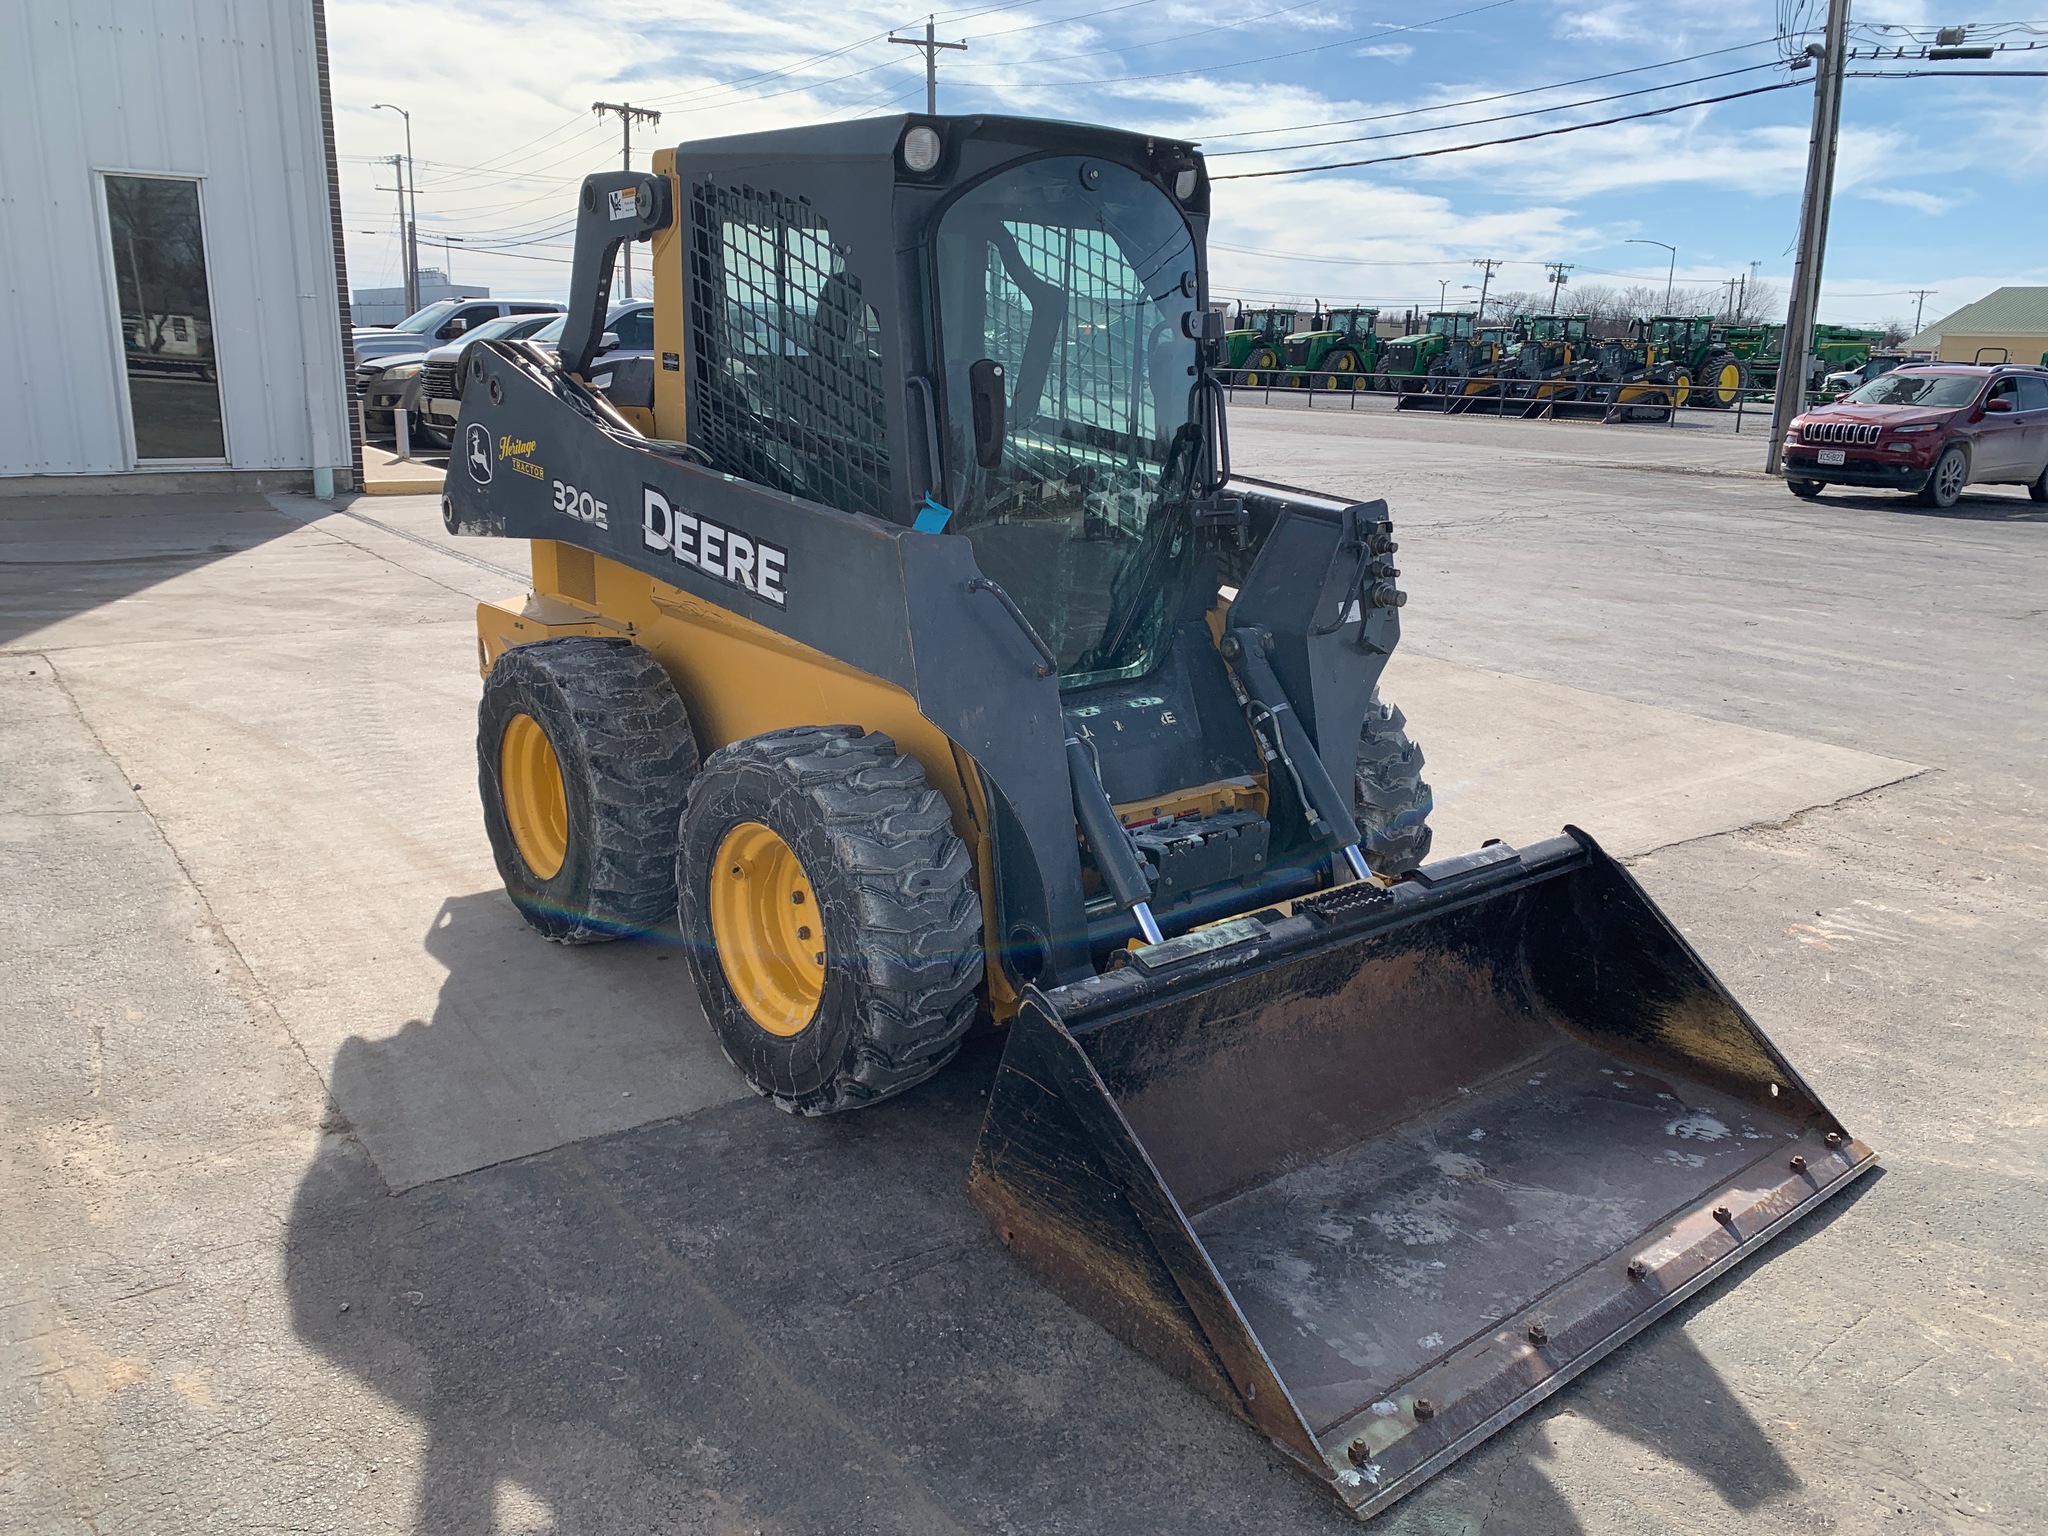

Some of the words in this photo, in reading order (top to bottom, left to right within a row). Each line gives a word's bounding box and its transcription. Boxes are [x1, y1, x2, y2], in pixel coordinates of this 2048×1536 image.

[499, 435, 537, 461] Heritage
[512, 459, 544, 478] TRACTOR
[553, 480, 608, 530] 320E
[644, 488, 786, 605] DEERE
